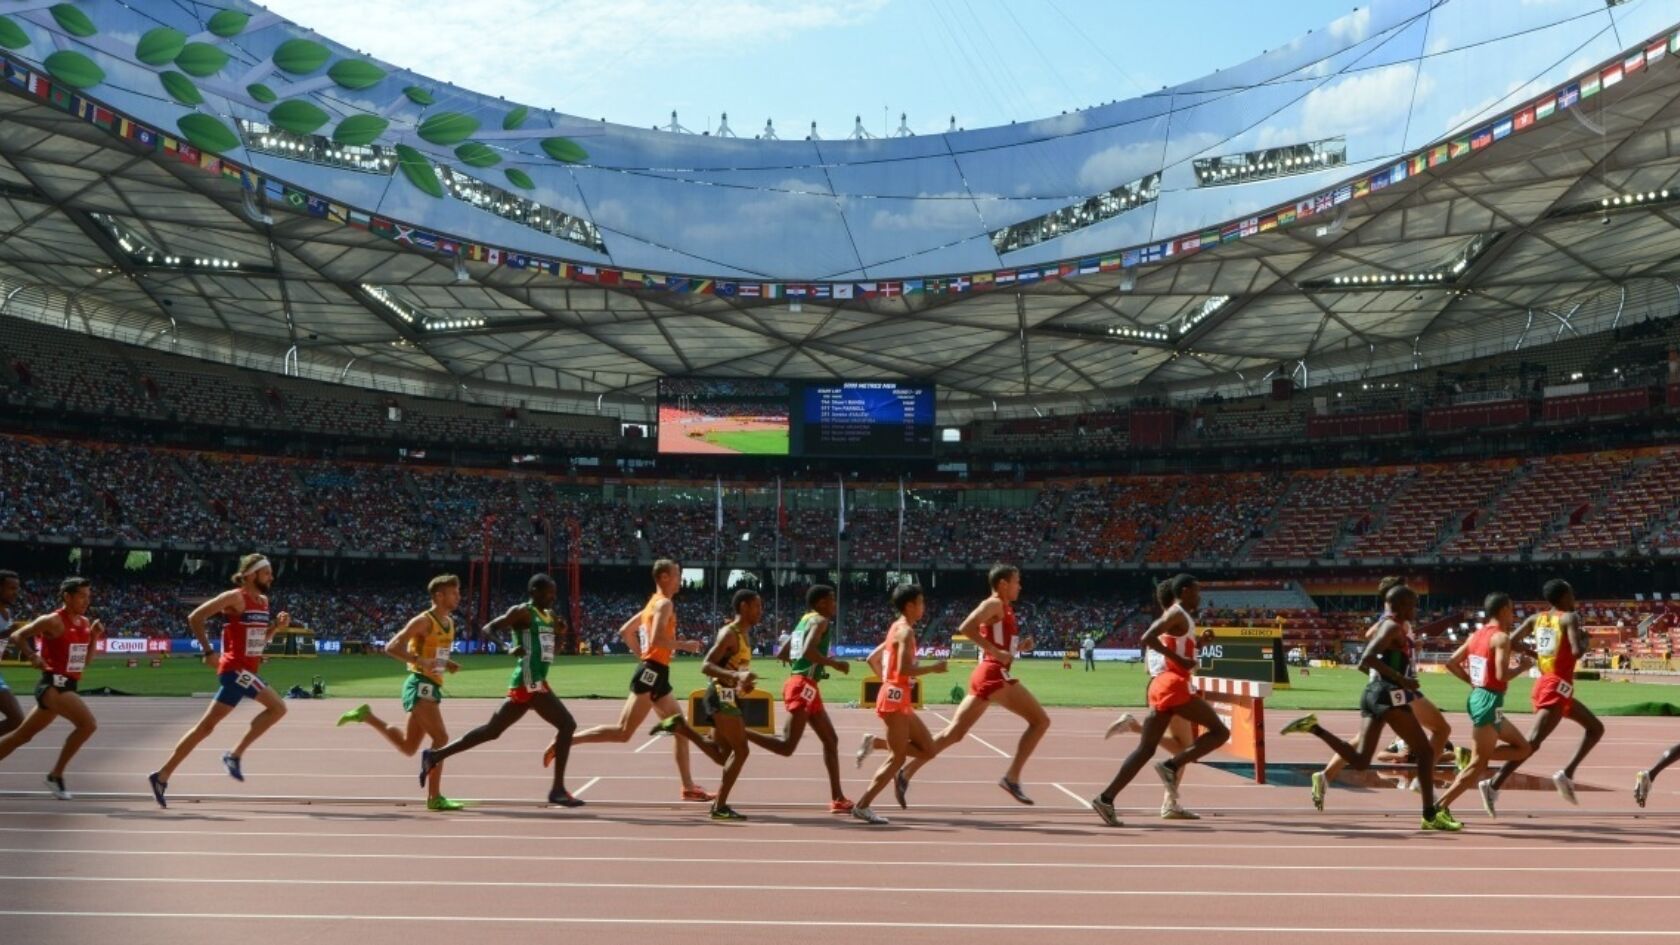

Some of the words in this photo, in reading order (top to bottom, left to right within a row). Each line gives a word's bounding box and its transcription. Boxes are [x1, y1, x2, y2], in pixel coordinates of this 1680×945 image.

[111, 640, 143, 650] Canon
[1539, 637, 1551, 648] 27
[239, 674, 251, 686] 10
[643, 671, 655, 683] 18
[421, 685, 428, 695] 6
[721, 690, 732, 700] 14
[803, 687, 814, 700] 12
[887, 688, 902, 700] 20
[1394, 692, 1402, 703] 9
